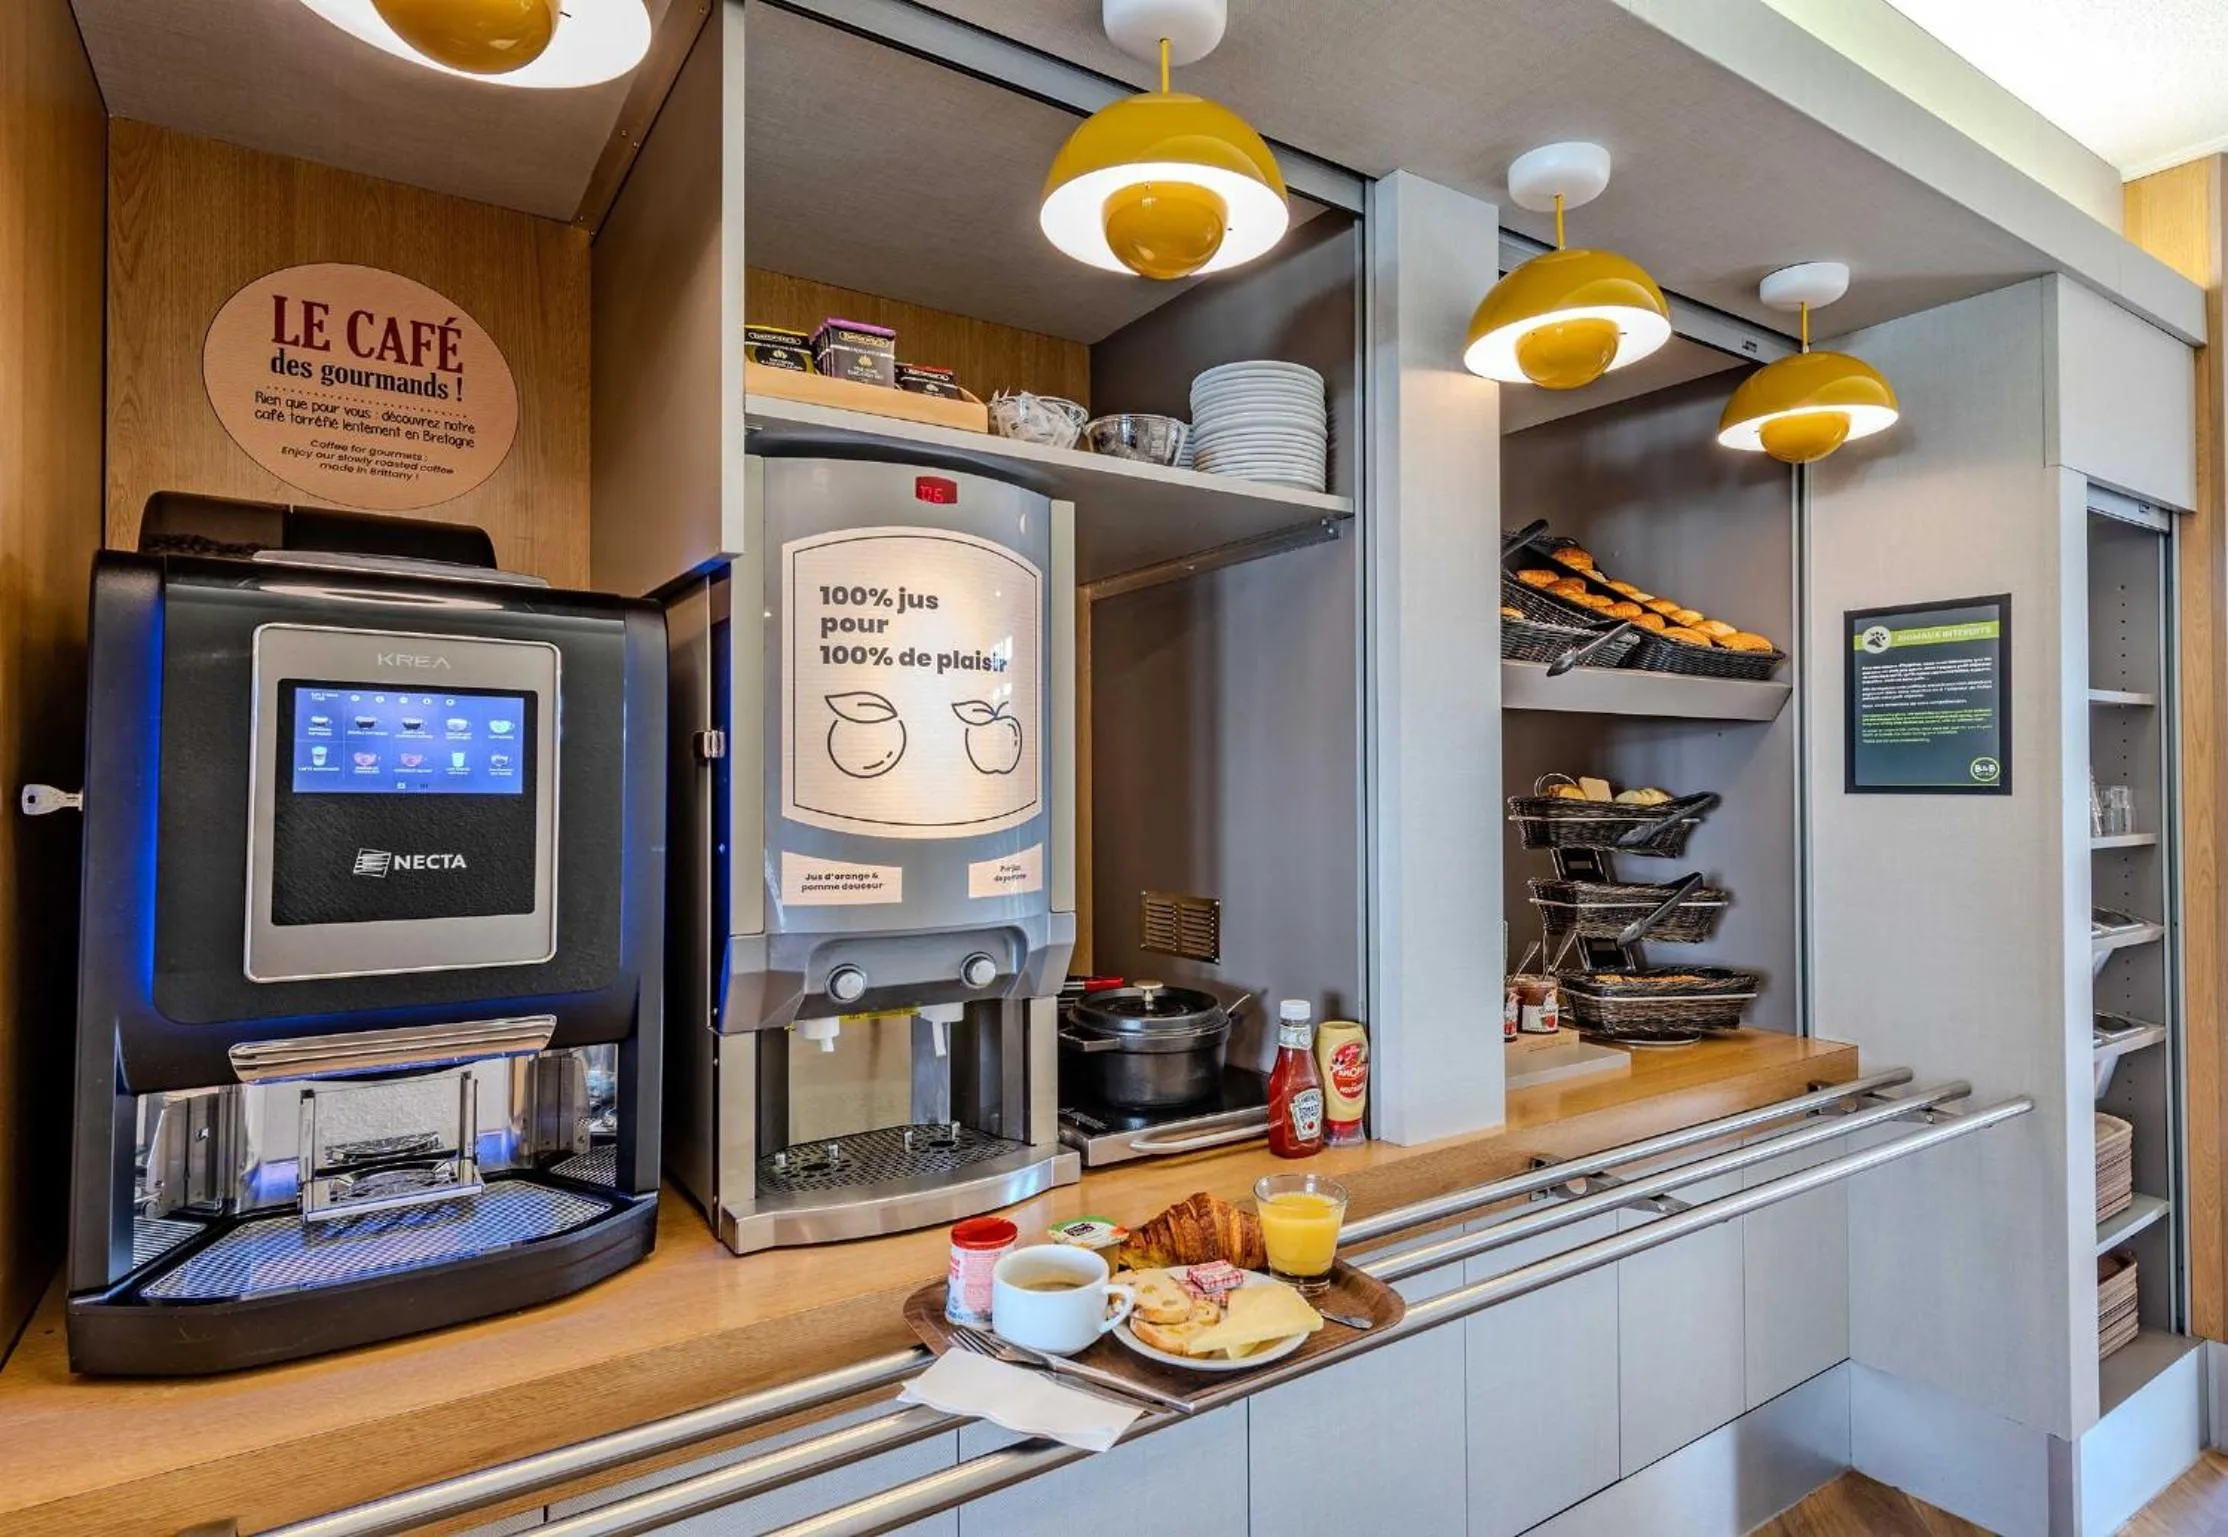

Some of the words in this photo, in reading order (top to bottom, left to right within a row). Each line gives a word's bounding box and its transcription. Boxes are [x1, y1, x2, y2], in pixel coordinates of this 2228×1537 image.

[271, 295, 331, 352] LE
[346, 310, 464, 374] CAFÉ
[271, 348, 313, 379] des
[321, 363, 449, 400] gourmands
[456, 377, 464, 402] !
[255, 391, 282, 407] Rien
[285, 398, 308, 413] que
[311, 401, 340, 416] pour
[344, 406, 371, 419] vous
[381, 410, 442, 430] découvrez
[444, 419, 476, 435] notre
[254, 407, 285, 423] café
[290, 411, 340, 429] torréfié
[342, 418, 401, 438] lentement
[405, 429, 420, 441] en
[423, 430, 476, 450] Bretagne
[281, 446, 313, 460] Enjoy
[315, 451, 336, 461] our
[338, 453, 373, 467] slowly
[375, 457, 418, 471] roasted
[420, 463, 454, 475] coffee
[310, 439, 348, 452] Coffee
[351, 444, 367, 454] for
[369, 448, 422, 462] gourmets
[319, 461, 354, 473] made
[356, 466, 368, 475] in
[370, 467, 413, 482] Brittany
[819, 586, 893, 608] 100%
[897, 587, 939, 614] jus
[820, 616, 889, 638] pour
[377, 652, 451, 669] KREA
[819, 645, 893, 667] 100%
[899, 648, 932, 667] de
[937, 650, 1008, 674] plaisir
[394, 853, 467, 871] NECTA
[801, 882, 840, 893] pomme
[805, 873, 822, 881] Jus
